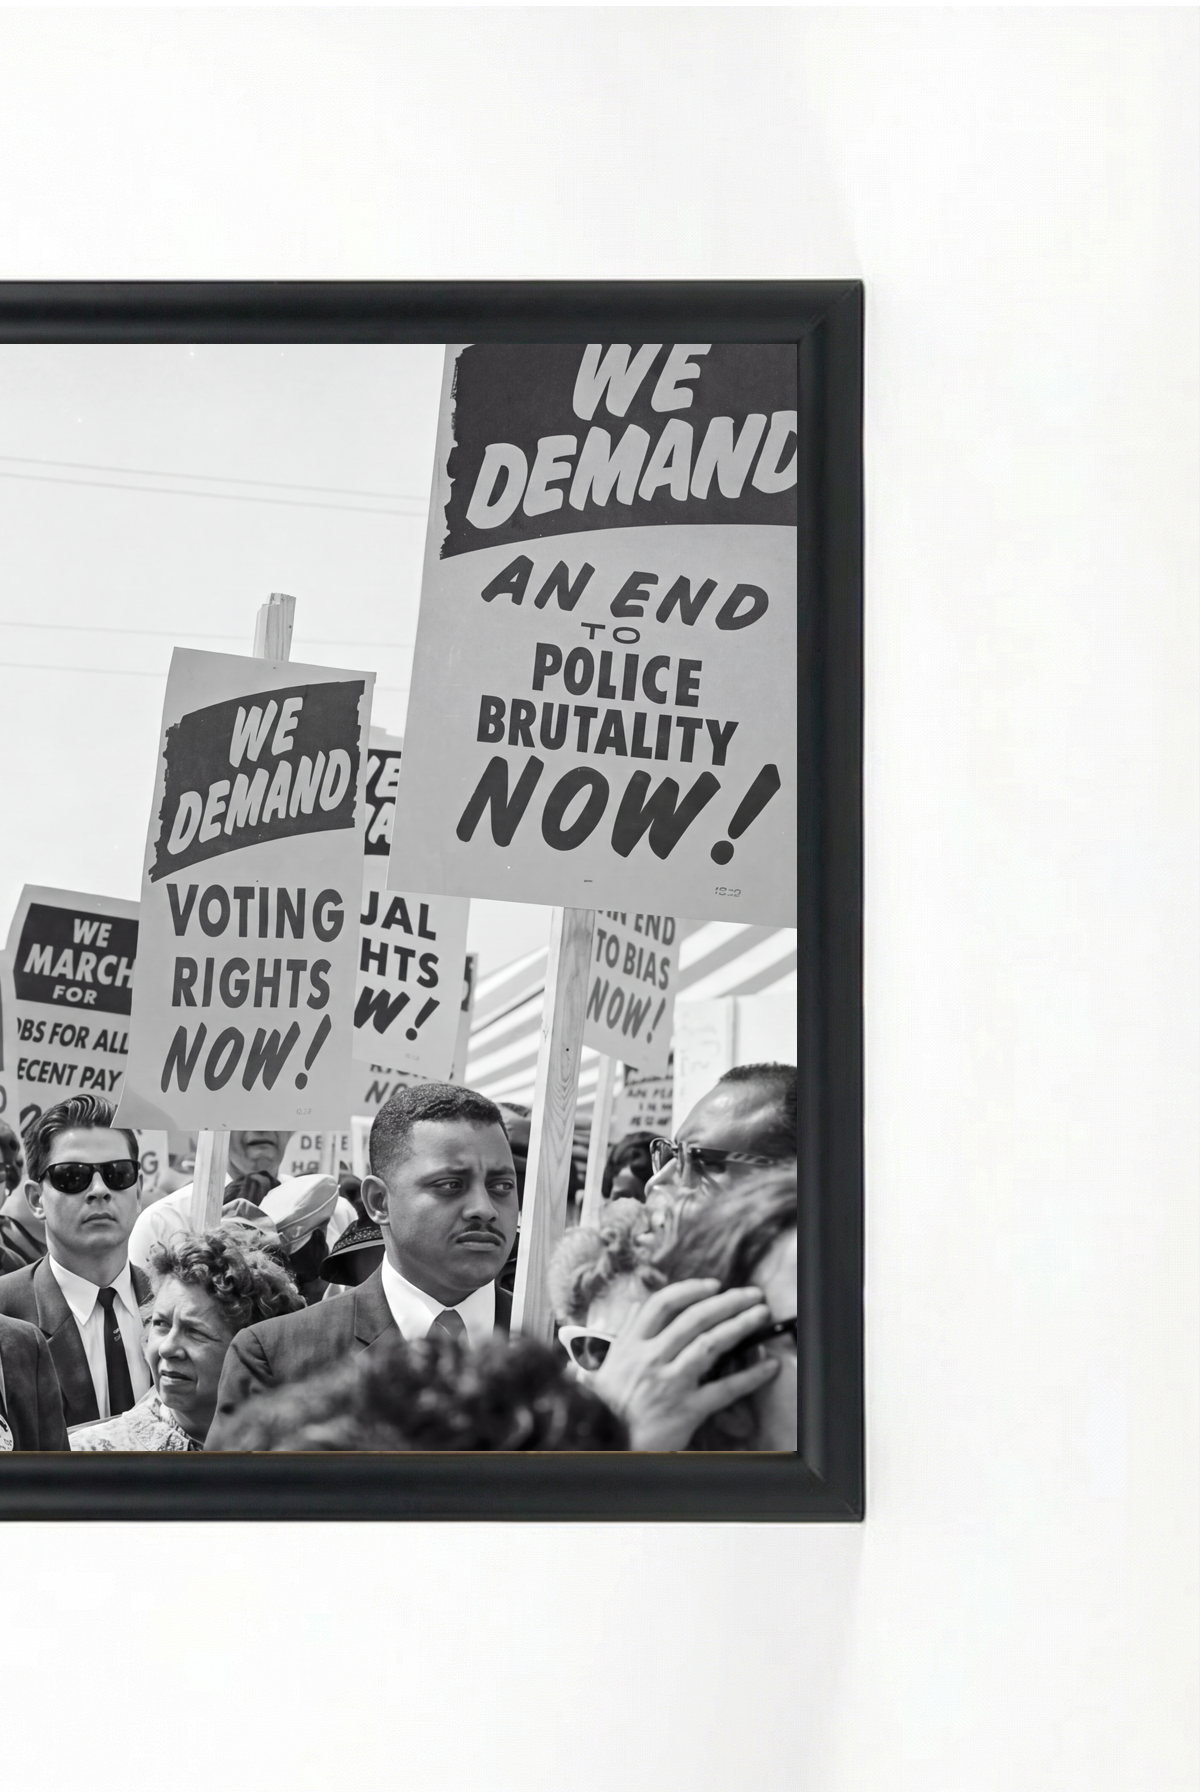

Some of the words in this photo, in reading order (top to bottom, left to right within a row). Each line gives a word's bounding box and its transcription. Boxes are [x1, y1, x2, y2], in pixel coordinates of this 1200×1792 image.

[572, 343, 711, 421] WE
[465, 410, 797, 529] DEMAND
[481, 555, 596, 611] AN
[610, 571, 769, 631] END
[580, 623, 640, 645] TO
[531, 642, 702, 708] POLICE
[229, 697, 303, 768] WE
[476, 695, 739, 766] BRUTALITY
[167, 748, 351, 855] DEMAND
[456, 755, 781, 866] NOW!
[73, 918, 112, 948] WE
[166, 884, 345, 943] VOTING
[634, 913, 676, 946] END
[23, 943, 136, 989] MARCH
[171, 956, 331, 1010] RIGHTS
[596, 928, 620, 968] TO
[622, 941, 671, 991] BIAS
[52, 985, 98, 1004] FOR
[586, 976, 666, 1044] NOW!
[48, 1022, 90, 1049] FOR
[96, 1029, 129, 1055] ALL
[160, 1014, 332, 1092] NOW!
[78, 1066, 123, 1092] PAY
